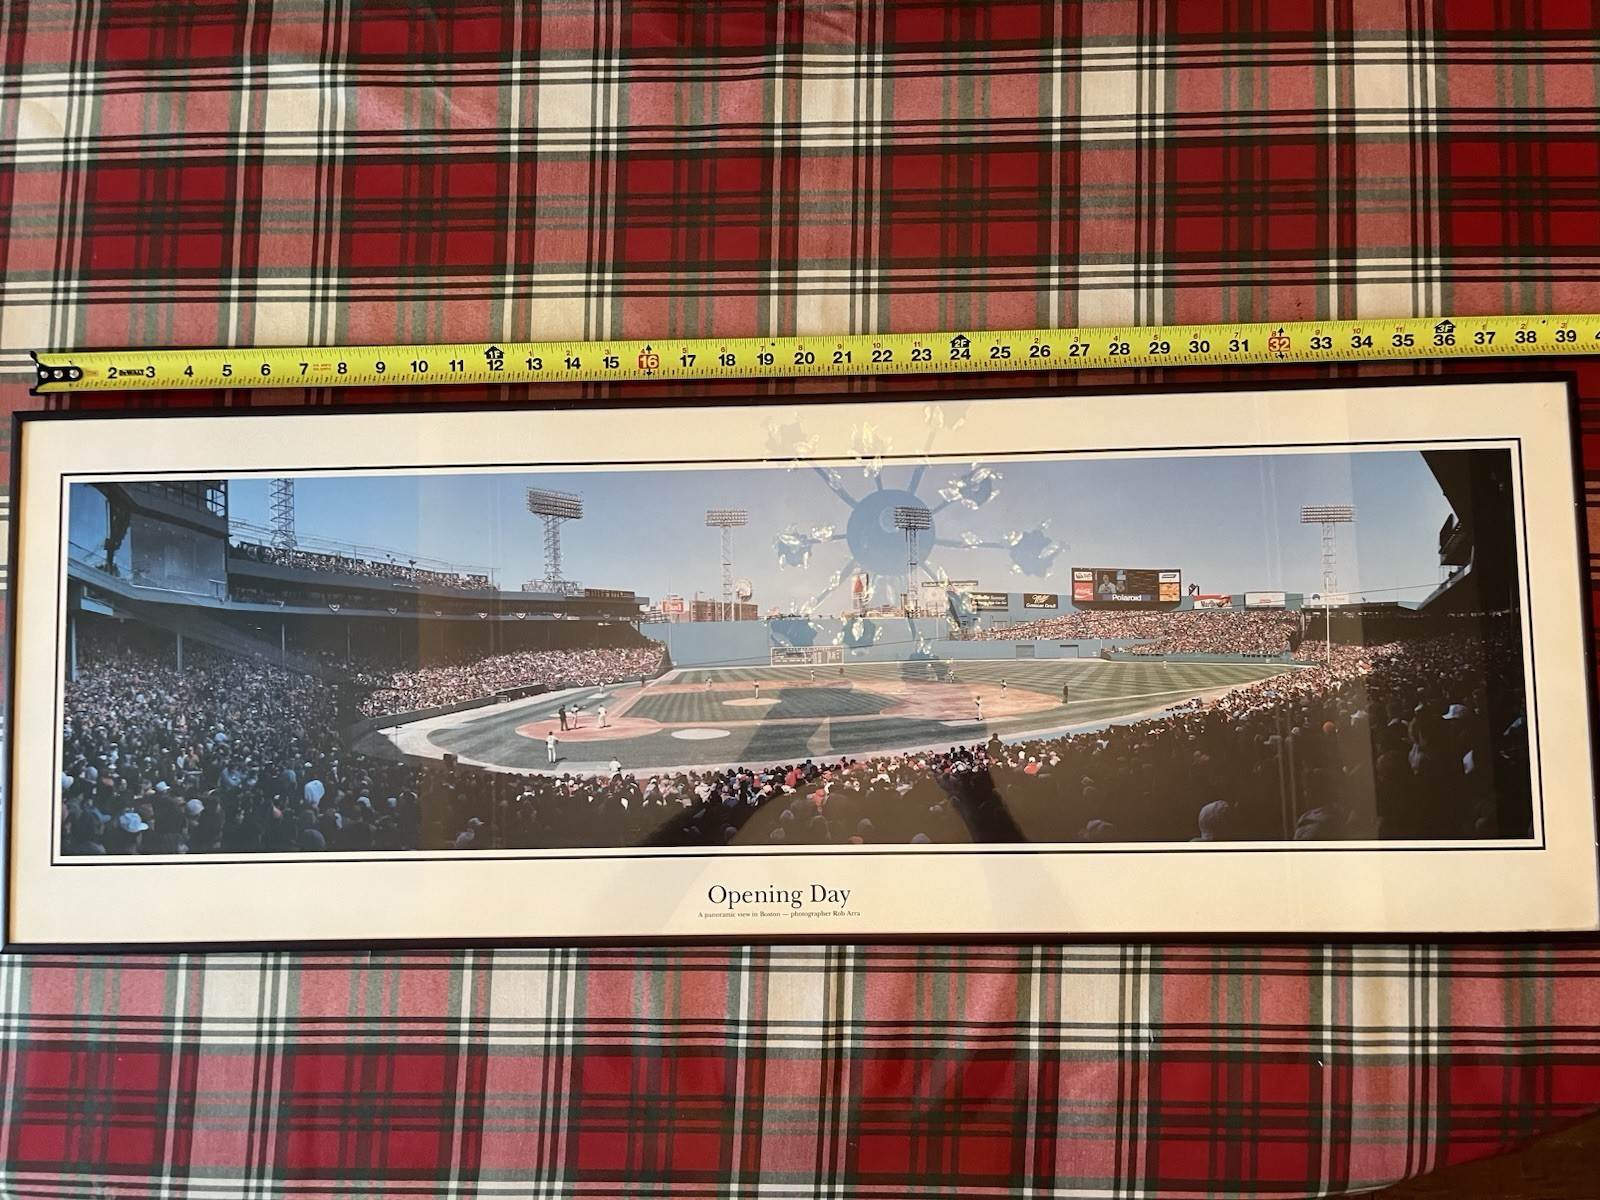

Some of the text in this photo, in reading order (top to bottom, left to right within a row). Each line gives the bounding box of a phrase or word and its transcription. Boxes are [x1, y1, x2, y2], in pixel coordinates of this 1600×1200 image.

[954, 339, 968, 348] 2F
[1437, 324, 1452, 333] 3F
[108, 367, 117, 379] 2
[146, 366, 155, 378] 3
[184, 366, 193, 377] 4
[222, 365, 232, 376] 5
[261, 364, 270, 376] 6
[300, 363, 308, 375] 7
[338, 363, 347, 374] 8
[376, 362, 385, 373] 9
[410, 361, 428, 373] 10
[449, 360, 463, 371] 11
[487, 360, 503, 371] 12
[526, 358, 542, 370] 13
[565, 358, 581, 369] 14
[602, 357, 619, 369] 15
[640, 356, 658, 367] 16
[680, 355, 696, 367] 17
[719, 354, 735, 366] 18
[757, 353, 773, 365] 19
[794, 352, 814, 364] 20
[833, 351, 851, 363] 21
[872, 350, 892, 362] 22
[912, 349, 931, 361] 23
[950, 349, 970, 360] 24
[990, 347, 1010, 359] 25
[1030, 345, 1050, 357] 26
[1070, 344, 1089, 356] 27
[1109, 343, 1130, 355] 28
[1150, 342, 1170, 354] 29
[1189, 341, 1209, 353] 30
[1229, 340, 1248, 352] 31
[1269, 339, 1290, 351] 32
[1310, 337, 1332, 349] 33
[1351, 336, 1373, 348] 34
[1392, 334, 1414, 347] 35
[1434, 334, 1455, 346] 36
[1475, 332, 1495, 344] 37
[1516, 331, 1536, 343] 38
[1556, 330, 1576, 342] 39
[708, 884, 851, 909] Opening Day
